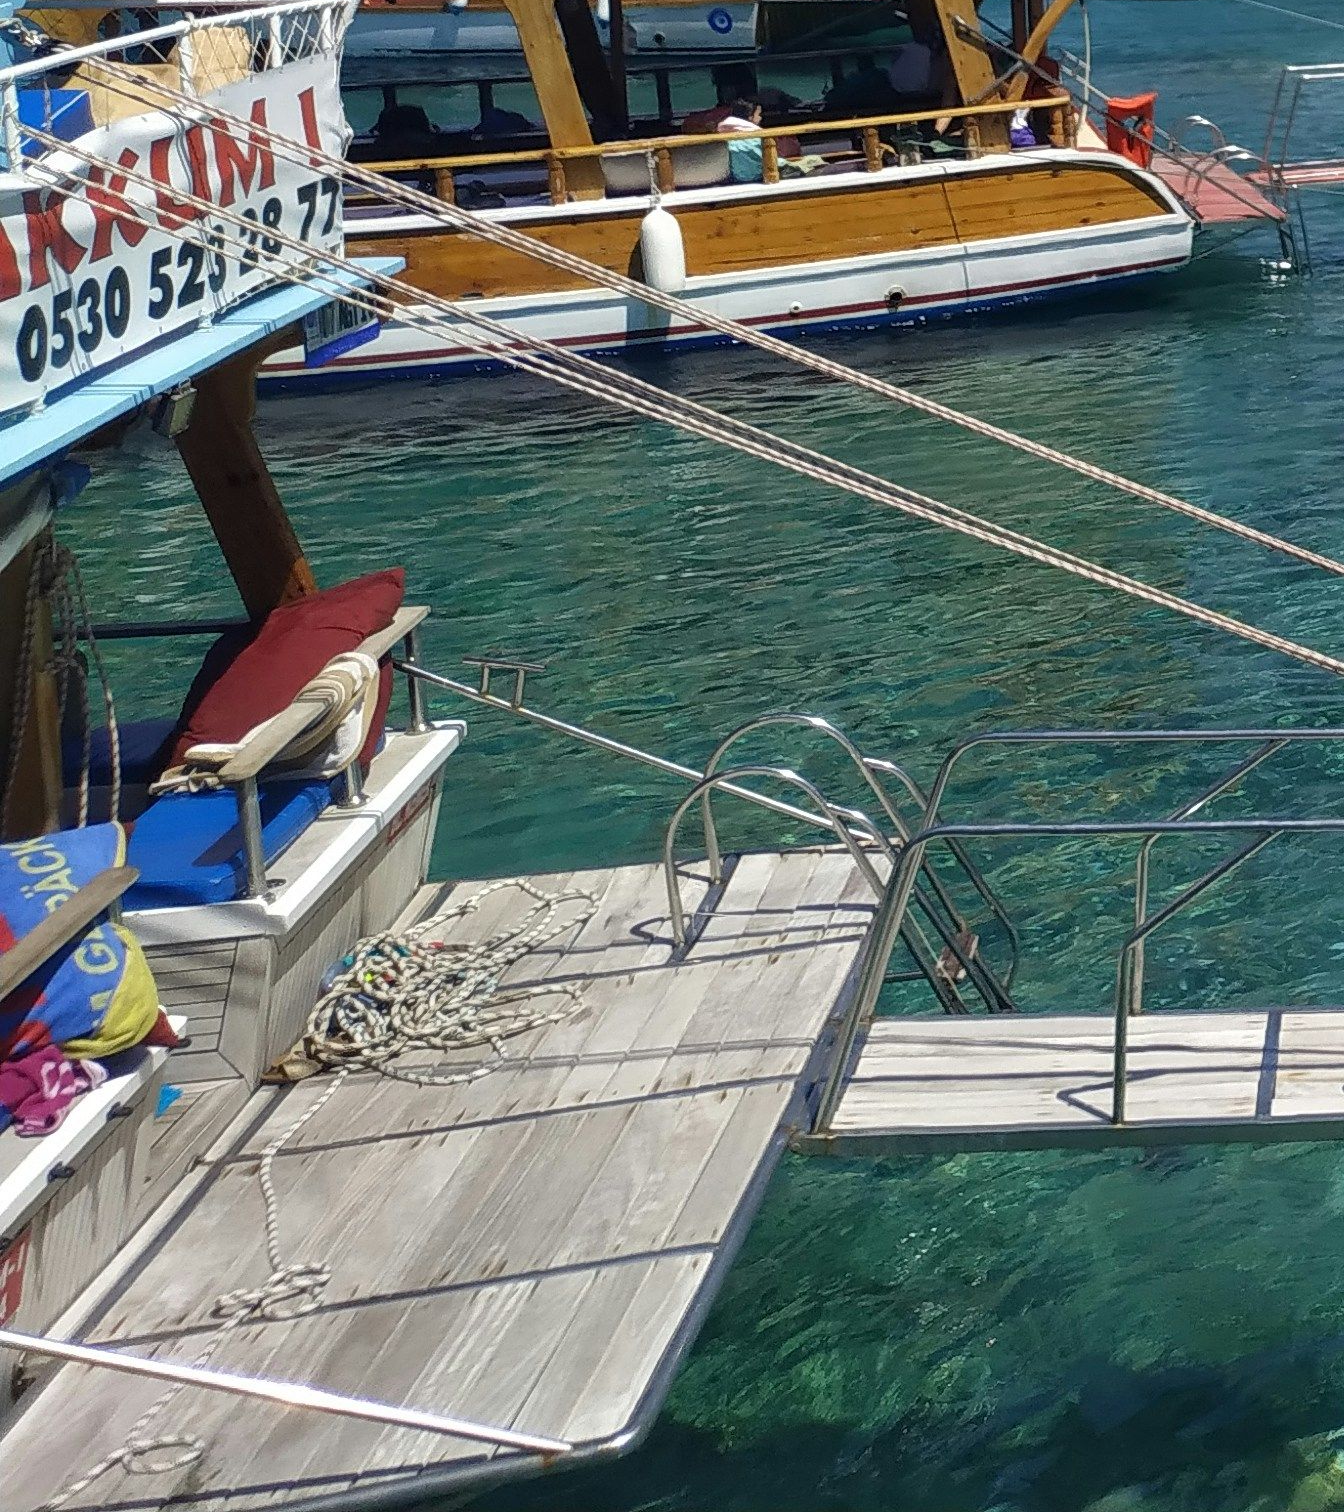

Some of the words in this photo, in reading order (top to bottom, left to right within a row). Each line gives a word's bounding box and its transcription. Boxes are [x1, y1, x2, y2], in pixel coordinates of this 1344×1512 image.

[16, 265, 131, 383] 0530
[148, 224, 226, 320] 523
[239, 197, 283, 277] 28
[297, 176, 340, 244] 77
